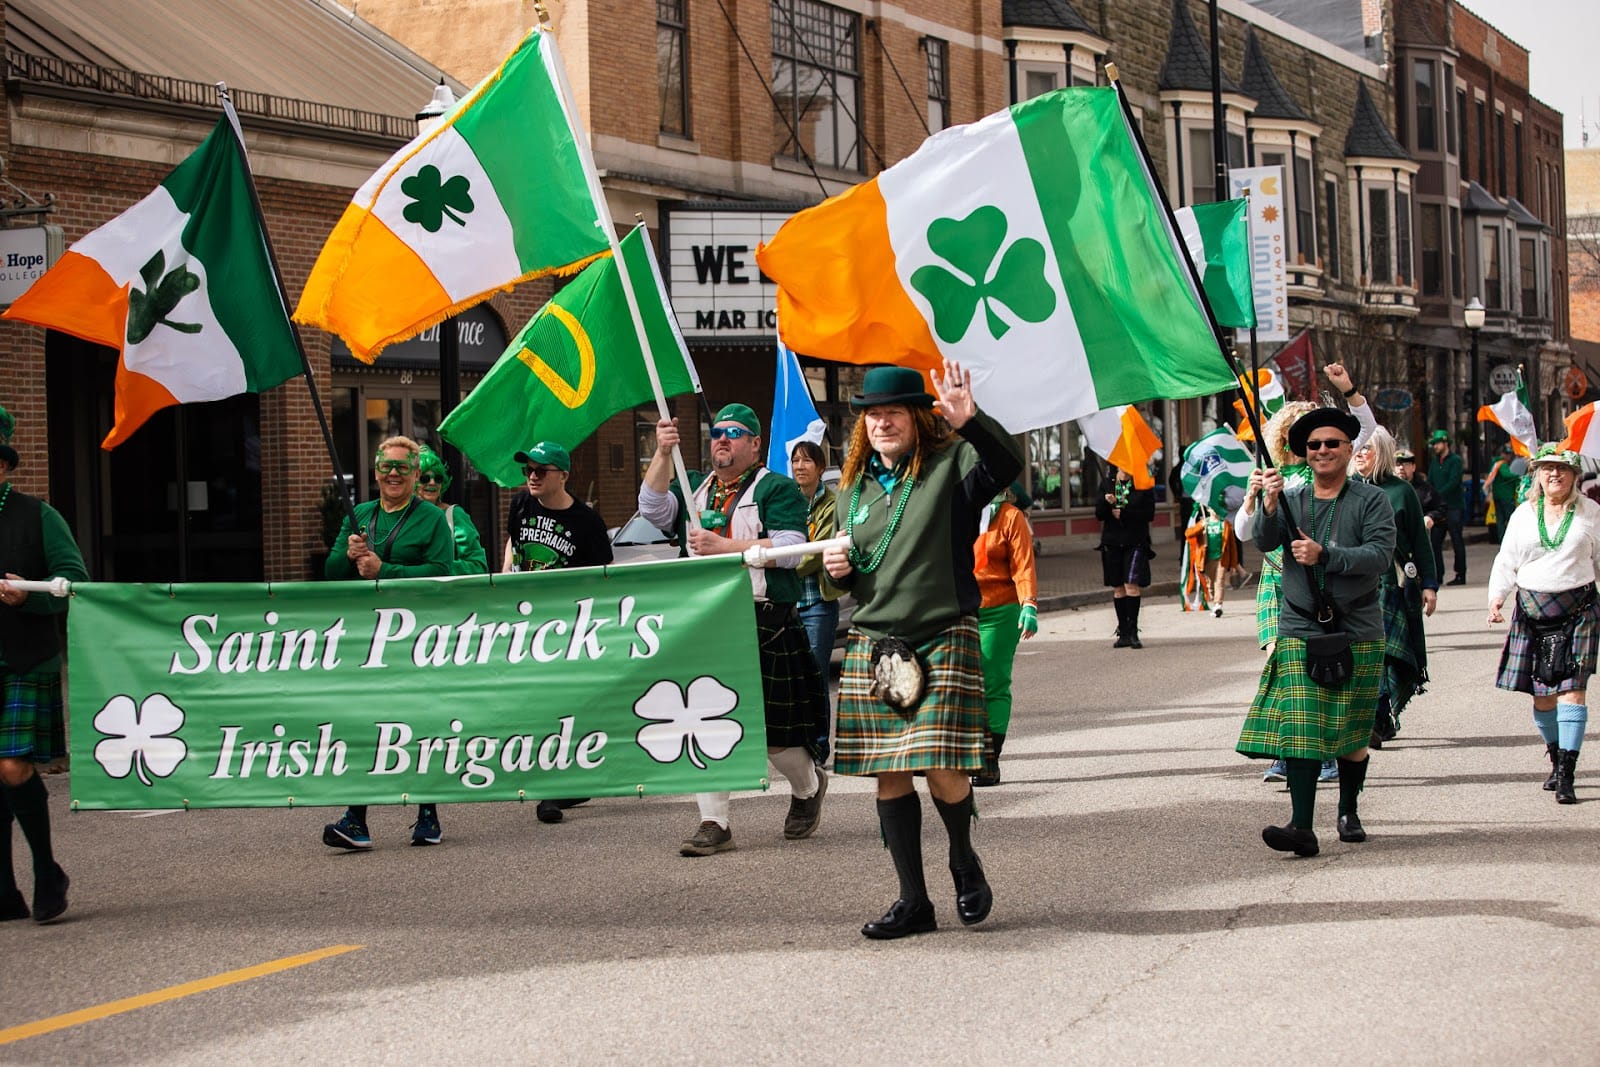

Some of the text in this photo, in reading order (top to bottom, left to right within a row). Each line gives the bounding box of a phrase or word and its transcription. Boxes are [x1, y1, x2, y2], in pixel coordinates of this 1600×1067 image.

[0, 270, 44, 281] OLLEGE
[6, 253, 44, 270] Hope
[691, 245, 750, 285] WE
[1273, 234, 1284, 331] DOWNTOWN
[695, 309, 746, 330] MAR
[536, 515, 557, 533] THE
[519, 527, 577, 557] EPRECHAUNS
[169, 596, 665, 676] Saint Patrick's
[208, 714, 609, 790] Irish Brigade
